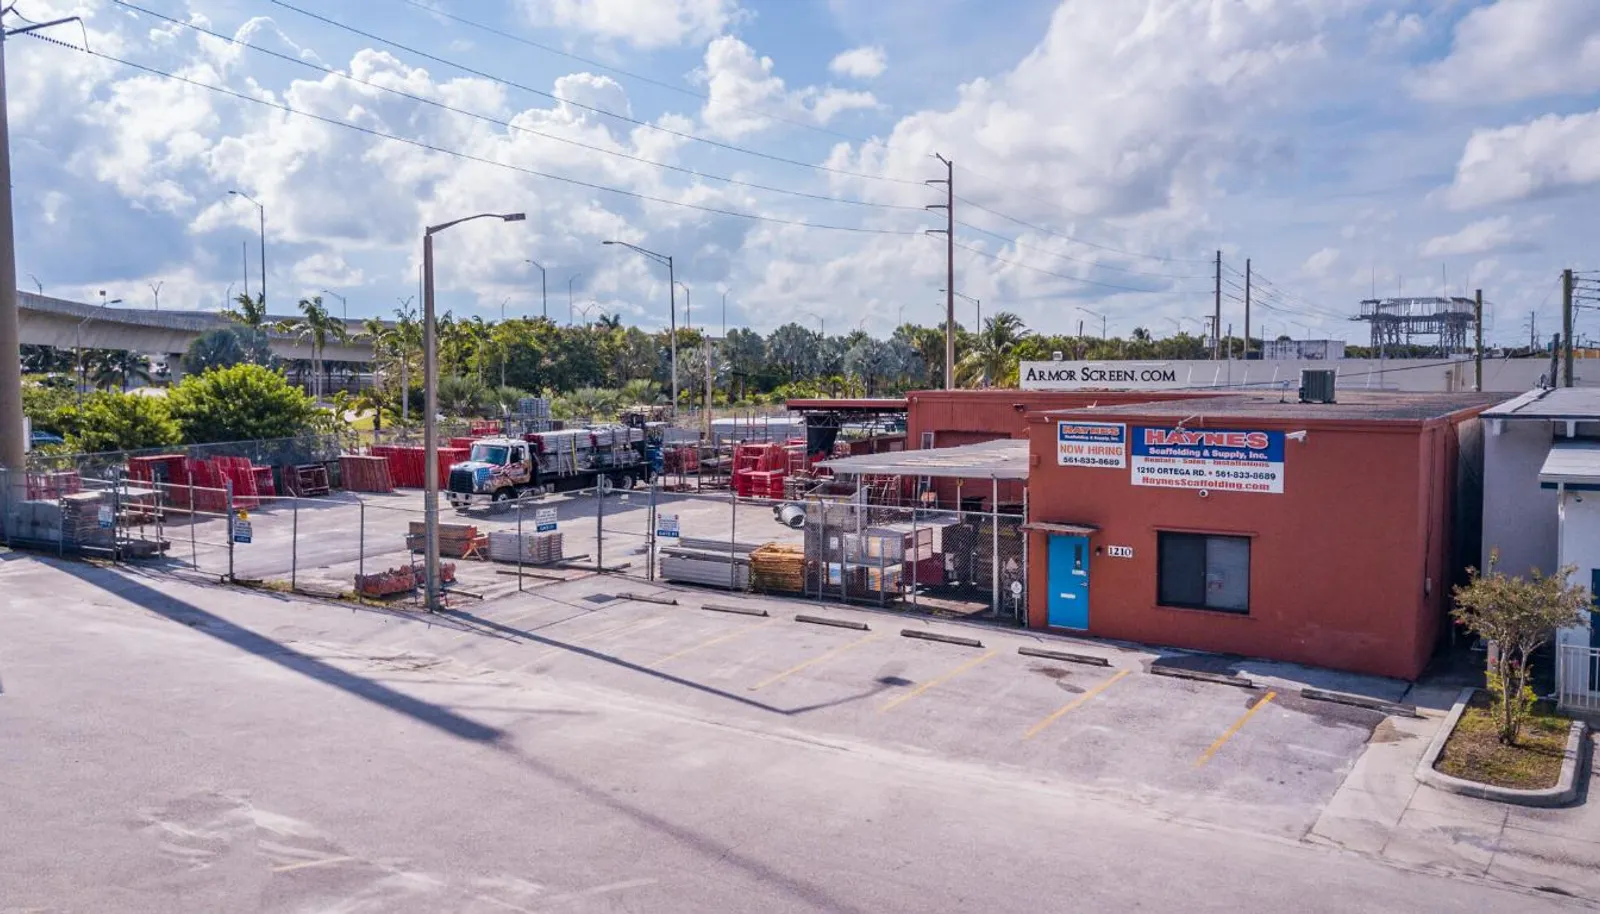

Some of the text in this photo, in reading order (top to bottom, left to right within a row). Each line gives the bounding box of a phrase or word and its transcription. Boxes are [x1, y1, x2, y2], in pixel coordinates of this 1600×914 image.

[1026, 367, 1077, 381] ARMOR
[1062, 425, 1120, 436] HAYNES
[1144, 428, 1269, 450] HAYNES
[1060, 444, 1123, 456] NOW HIRING
[1148, 446, 1268, 460] Scaffolding & Supply, Inc.
[1063, 456, 1120, 466] 561-833-8689
[1136, 466, 1276, 480] 1210 ORTEGA RD. 561-833-8689
[1142, 476, 1270, 490] HaynesScaffolding.com
[1109, 547, 1131, 557] 1210
